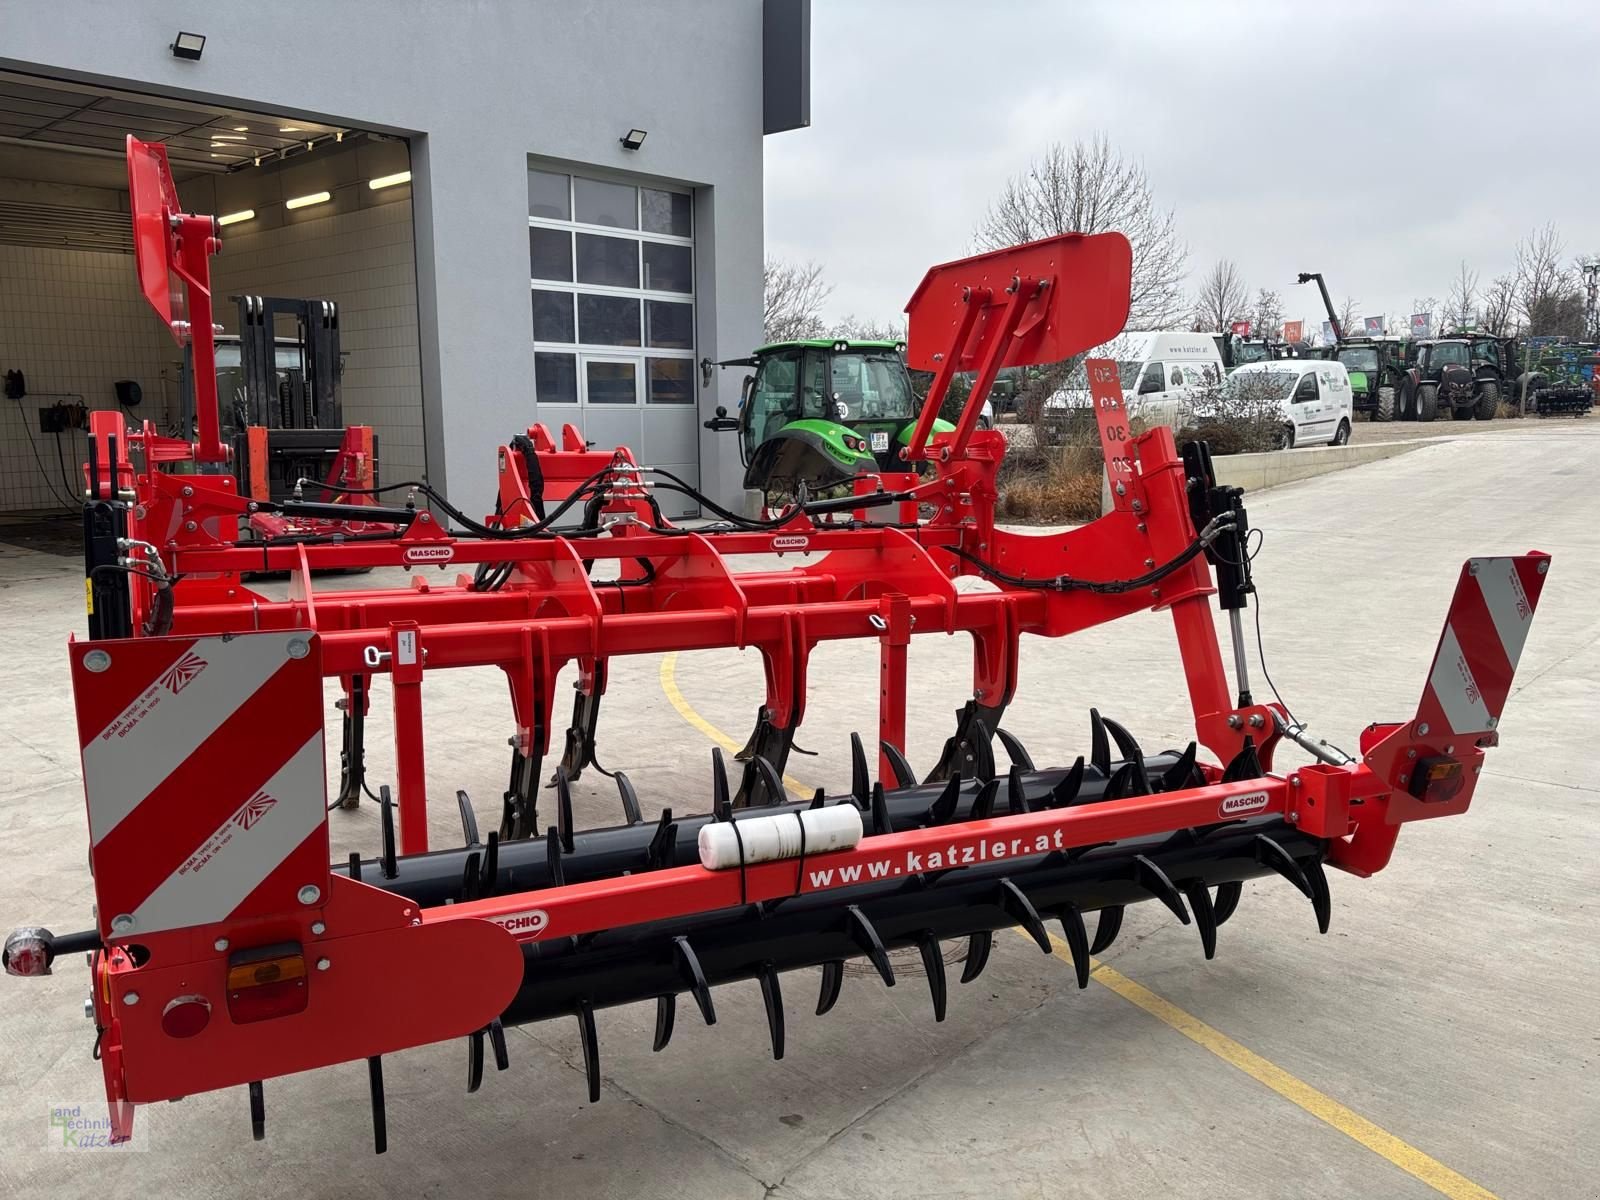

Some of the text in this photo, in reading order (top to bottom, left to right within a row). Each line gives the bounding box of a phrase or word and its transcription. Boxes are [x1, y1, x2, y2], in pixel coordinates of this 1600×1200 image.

[410, 549, 450, 557] MASCHIO
[102, 720, 123, 740] BICMA
[117, 718, 139, 738] BICMA
[1225, 795, 1266, 809] MASCHIO
[178, 857, 198, 875] BICMA
[192, 854, 213, 873] BICMA
[809, 828, 1064, 888] www.katzler.at
